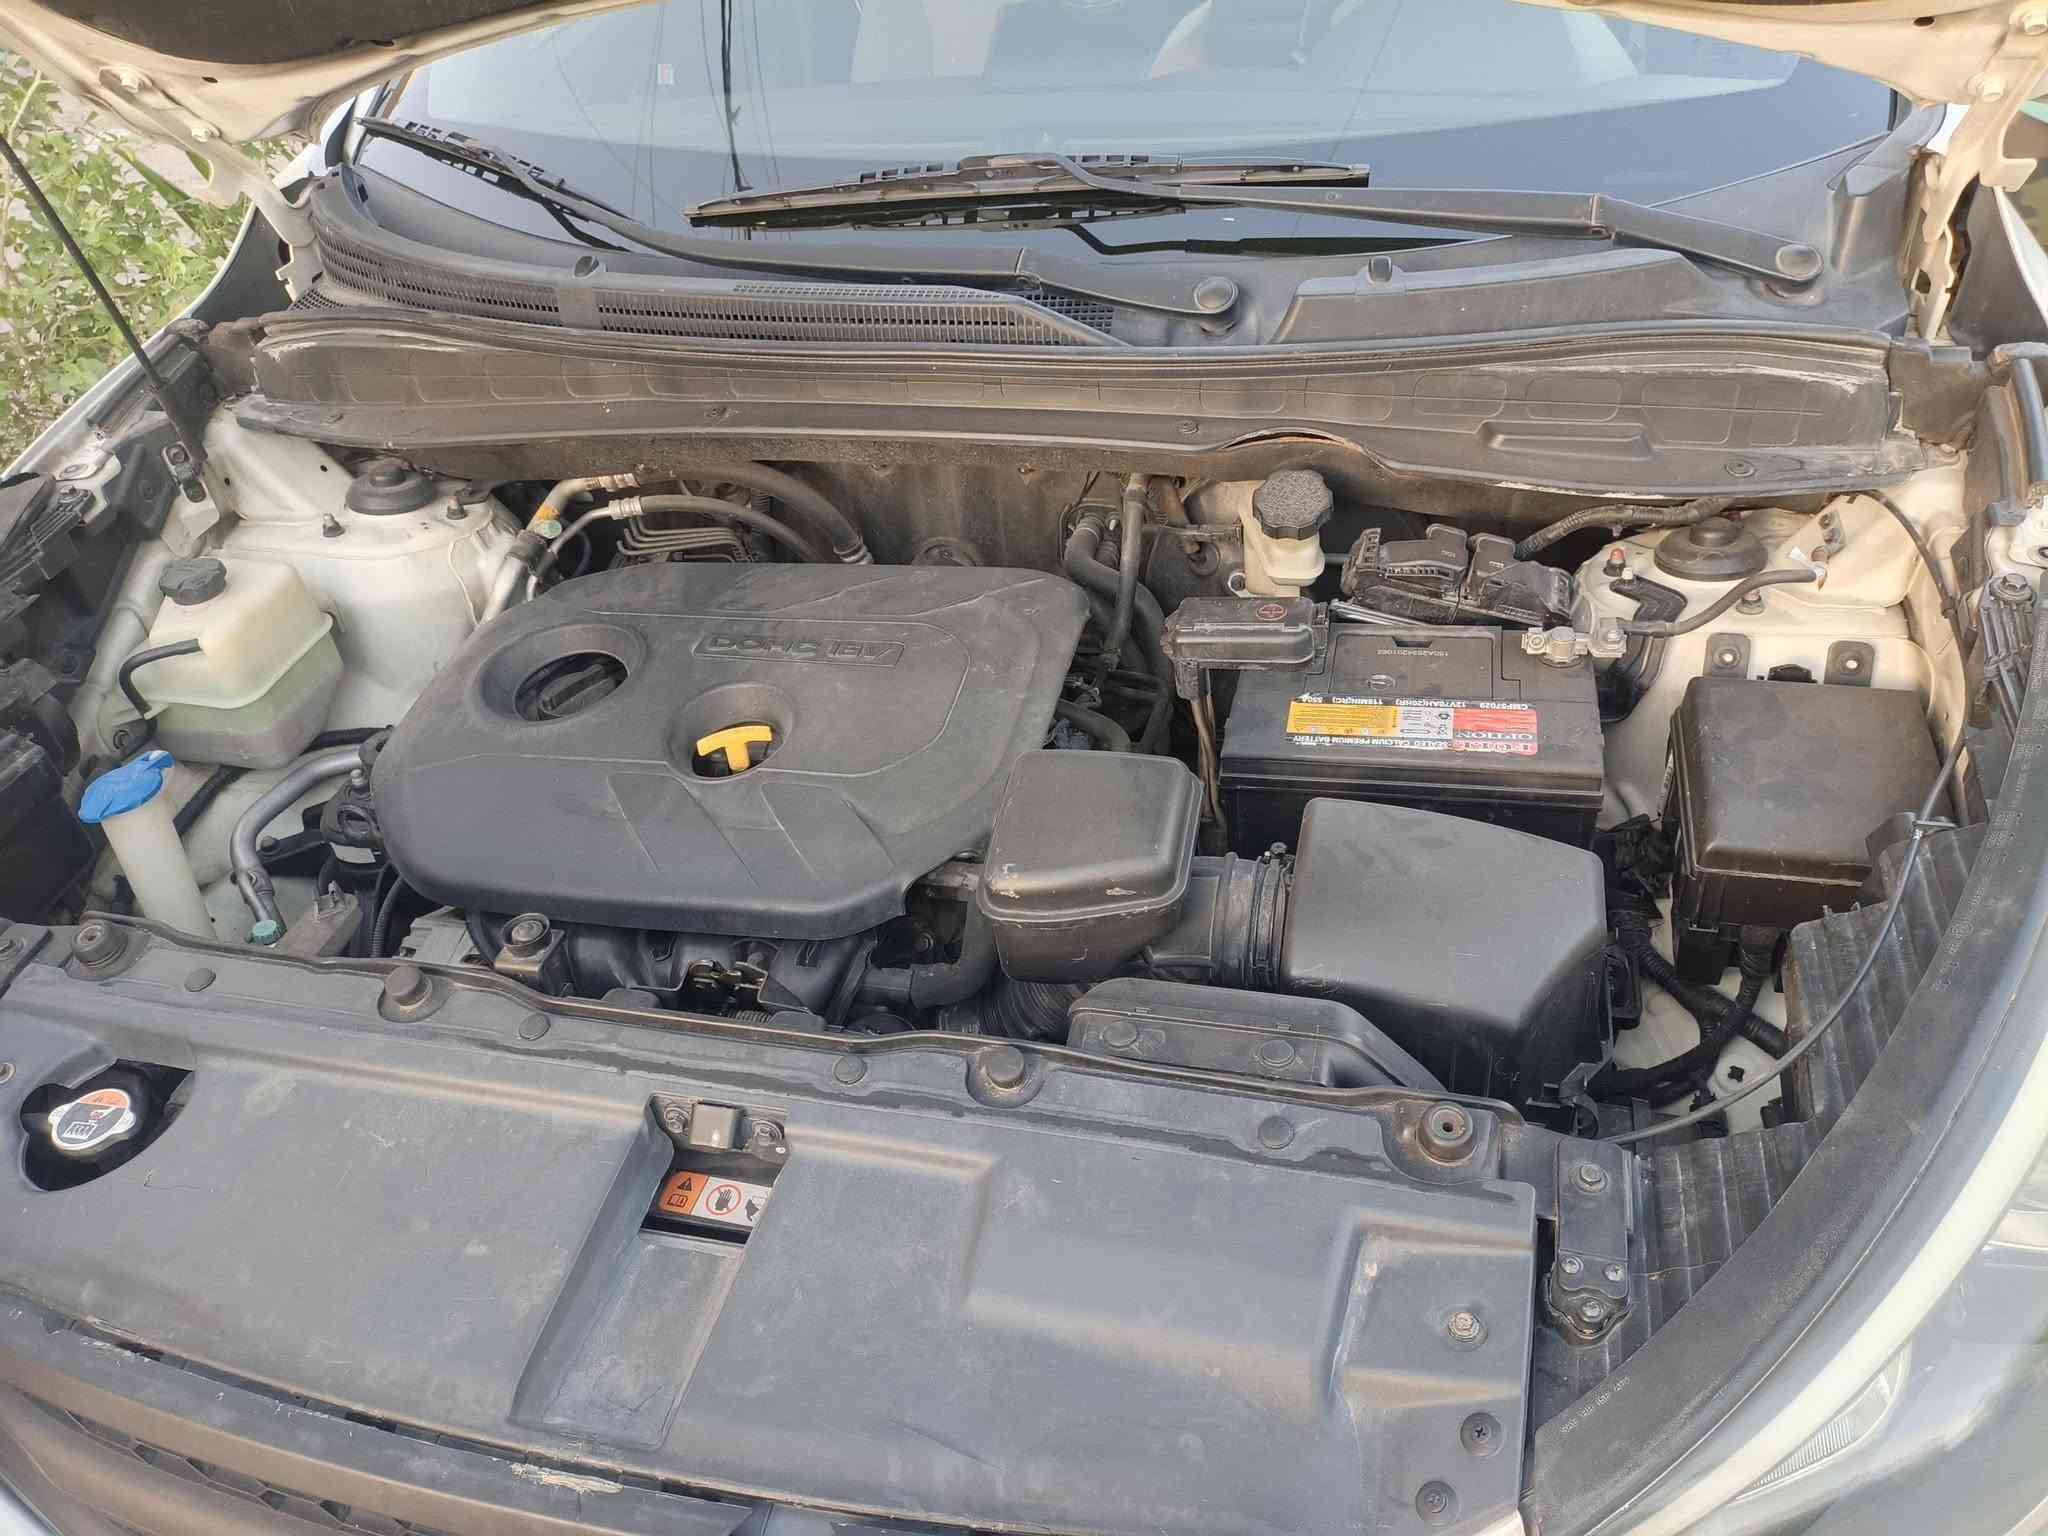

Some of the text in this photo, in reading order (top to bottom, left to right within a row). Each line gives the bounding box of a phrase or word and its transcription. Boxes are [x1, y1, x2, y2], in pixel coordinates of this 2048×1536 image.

[1293, 734, 1330, 744] BATTERY
[1455, 731, 1533, 740] OPTION
[1332, 736, 1370, 745] PREMIUM
[1371, 738, 1409, 747] CALCIUM
